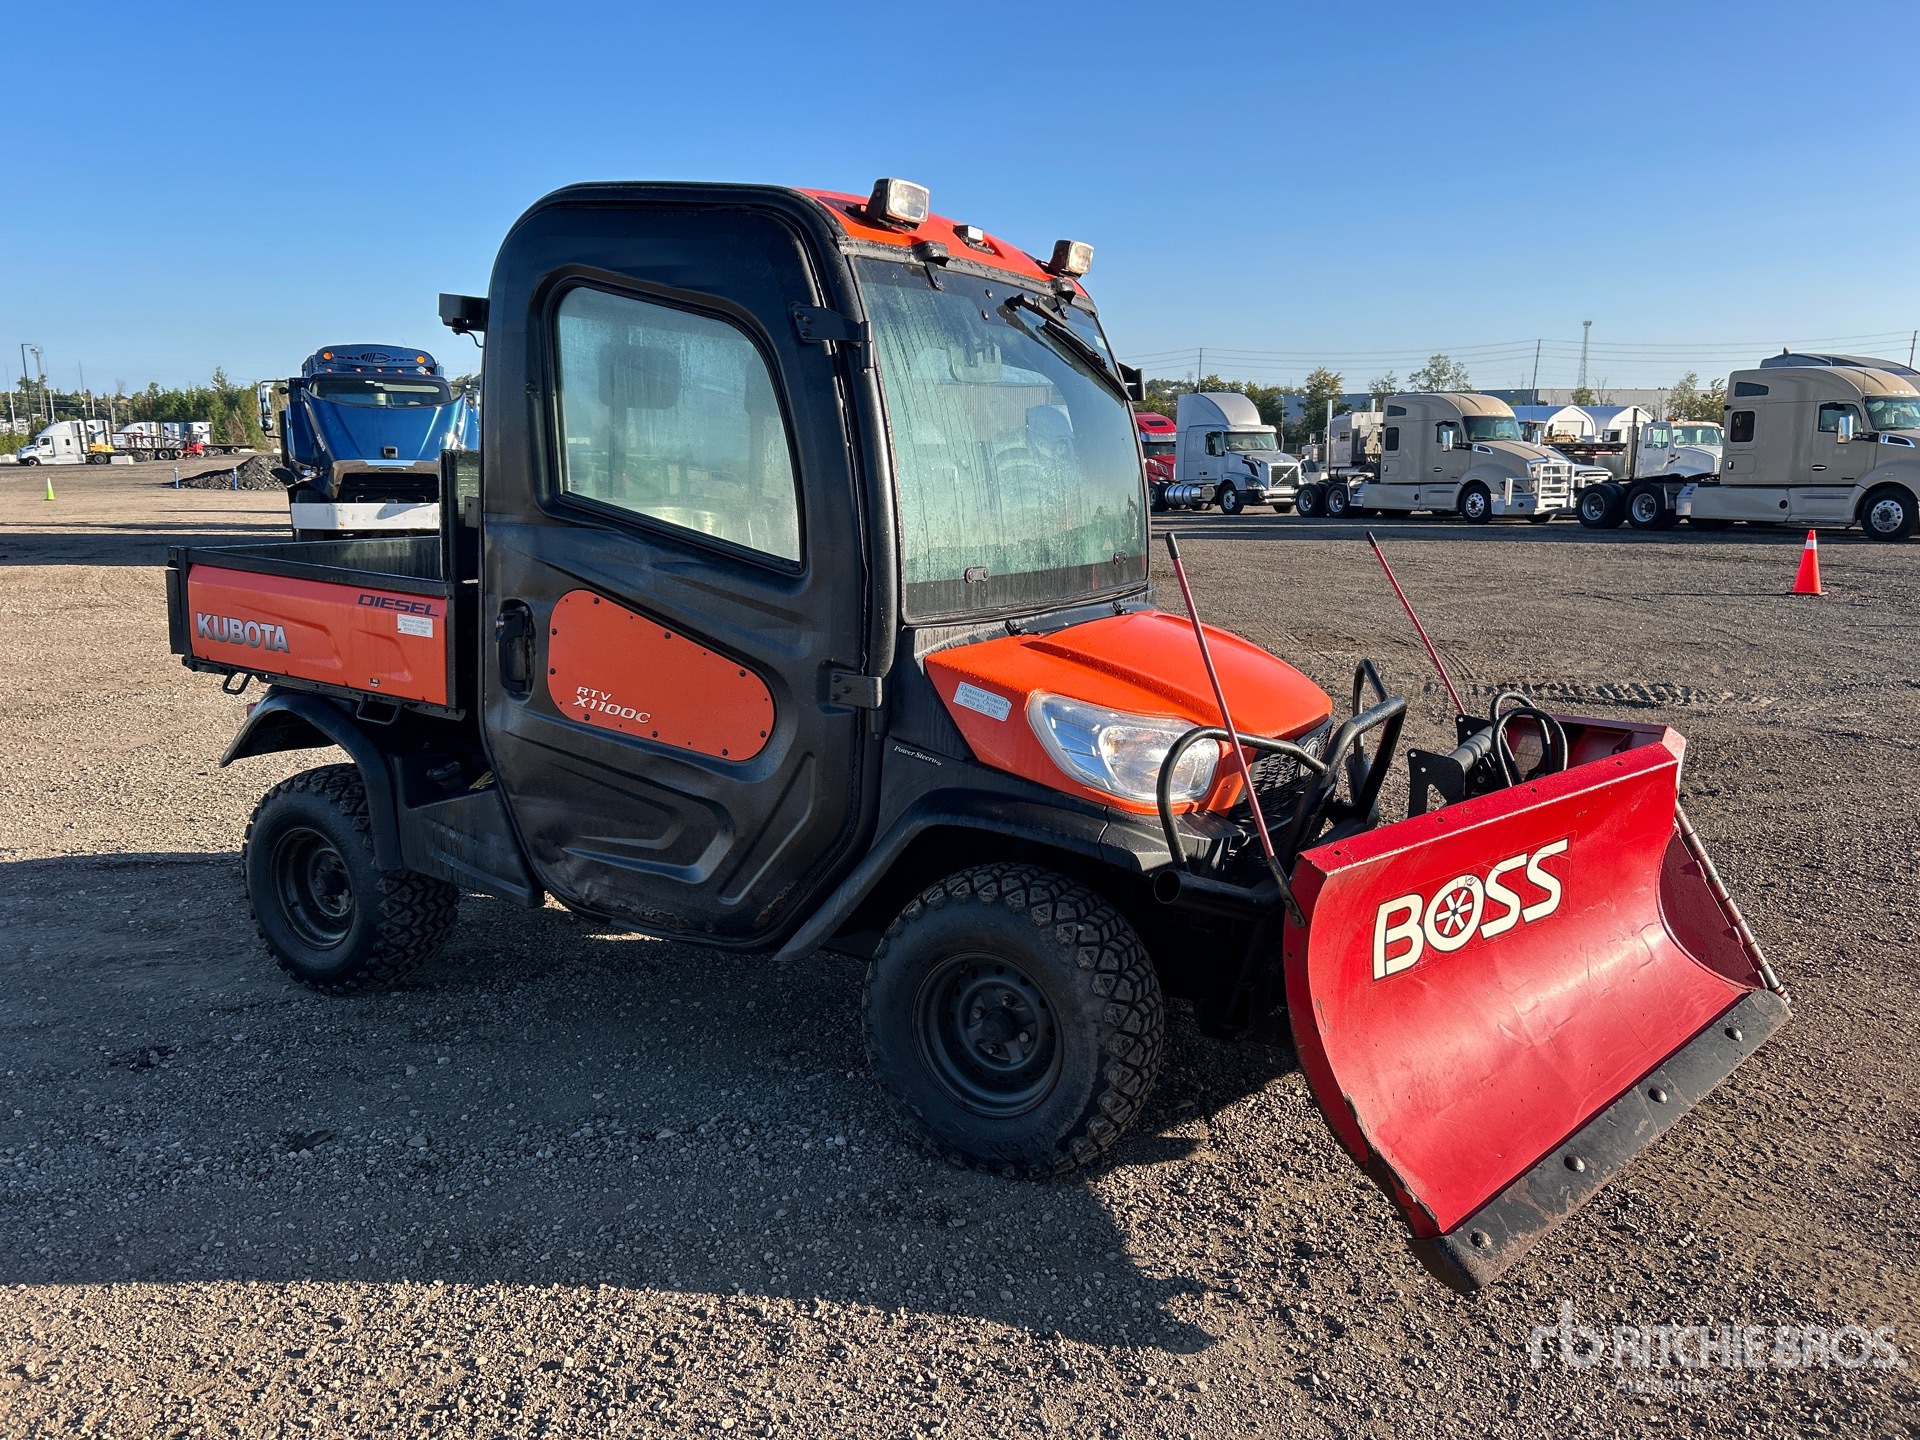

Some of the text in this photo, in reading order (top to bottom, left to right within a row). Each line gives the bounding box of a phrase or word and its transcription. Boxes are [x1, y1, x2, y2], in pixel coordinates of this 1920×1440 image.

[358, 594, 439, 617] DIESEL
[196, 611, 290, 654] KUBOTA
[576, 686, 613, 701] RTV
[573, 695, 651, 724] X1100C
[894, 745, 915, 757] Power
[1372, 838, 1569, 982] BOSS
